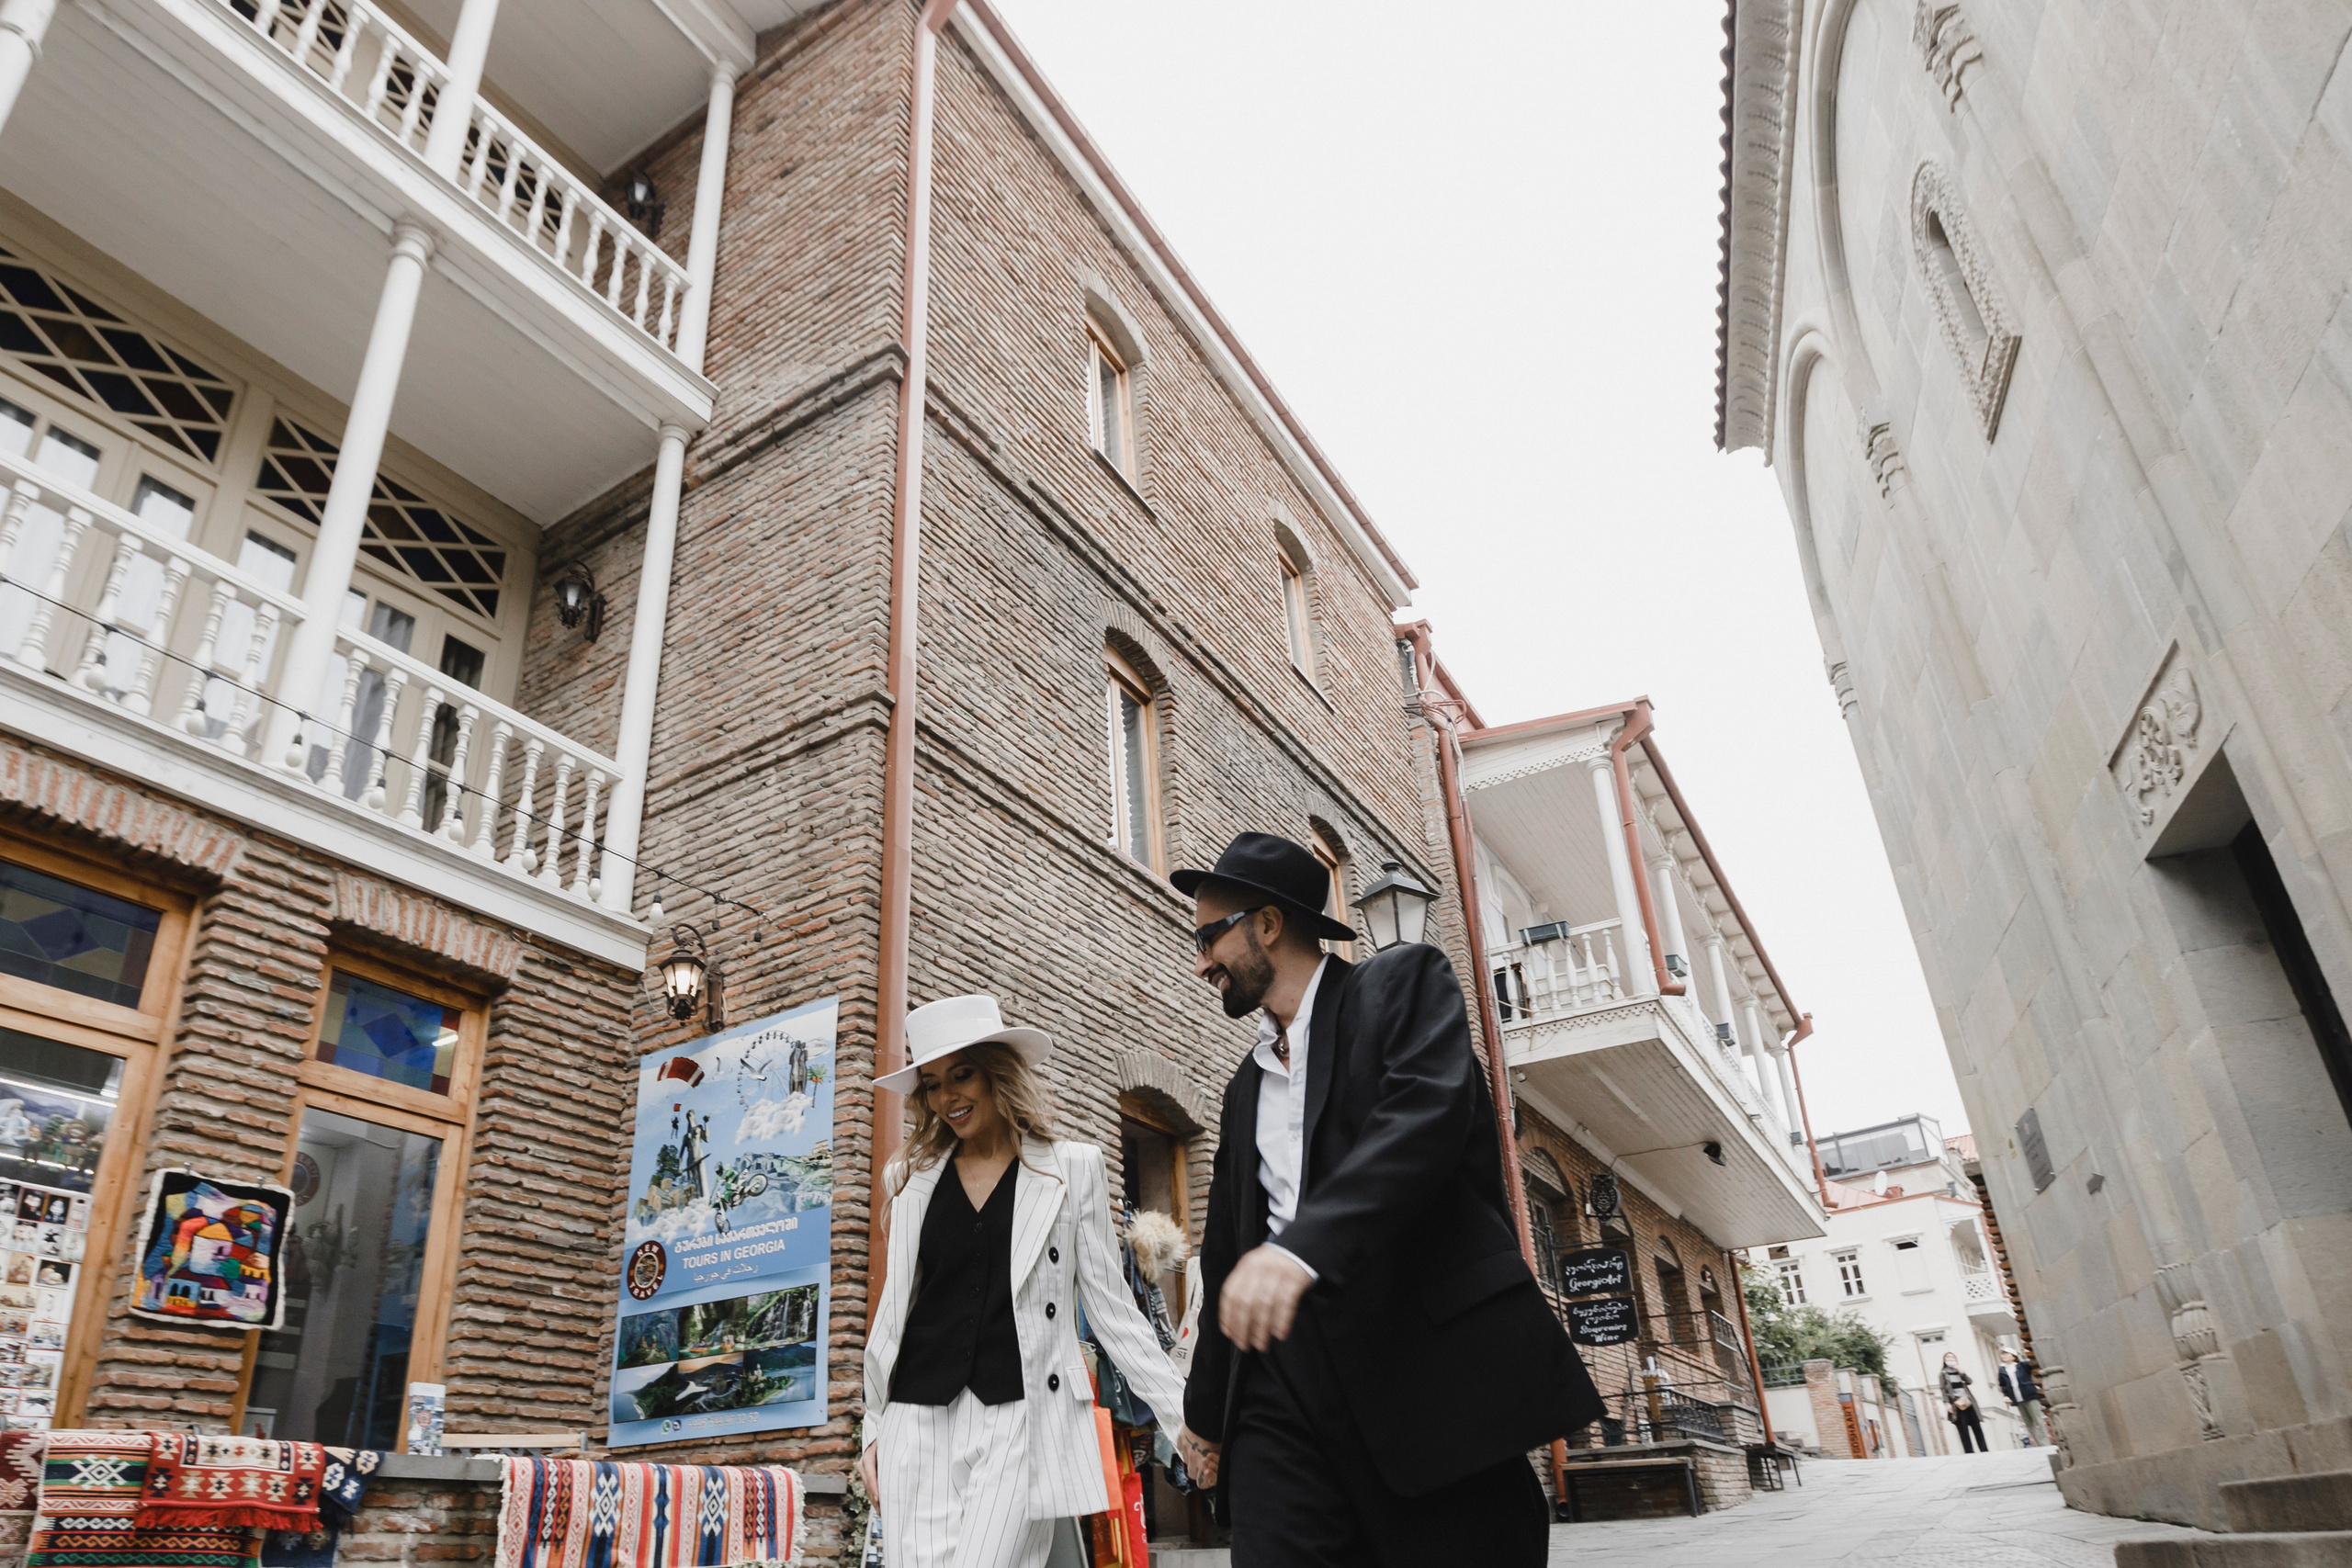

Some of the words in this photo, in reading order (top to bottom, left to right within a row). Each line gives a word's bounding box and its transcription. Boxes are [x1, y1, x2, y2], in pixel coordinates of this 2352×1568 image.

[637, 1244, 660, 1258] NEW
[683, 1252, 718, 1269] TOURS
[720, 1249, 732, 1262] IN
[733, 1238, 786, 1259] GEORGIA
[629, 1275, 663, 1298] TRAVEL
[1579, 1324, 1627, 1334] Souvenirs
[1590, 1333, 1619, 1342] Wine
